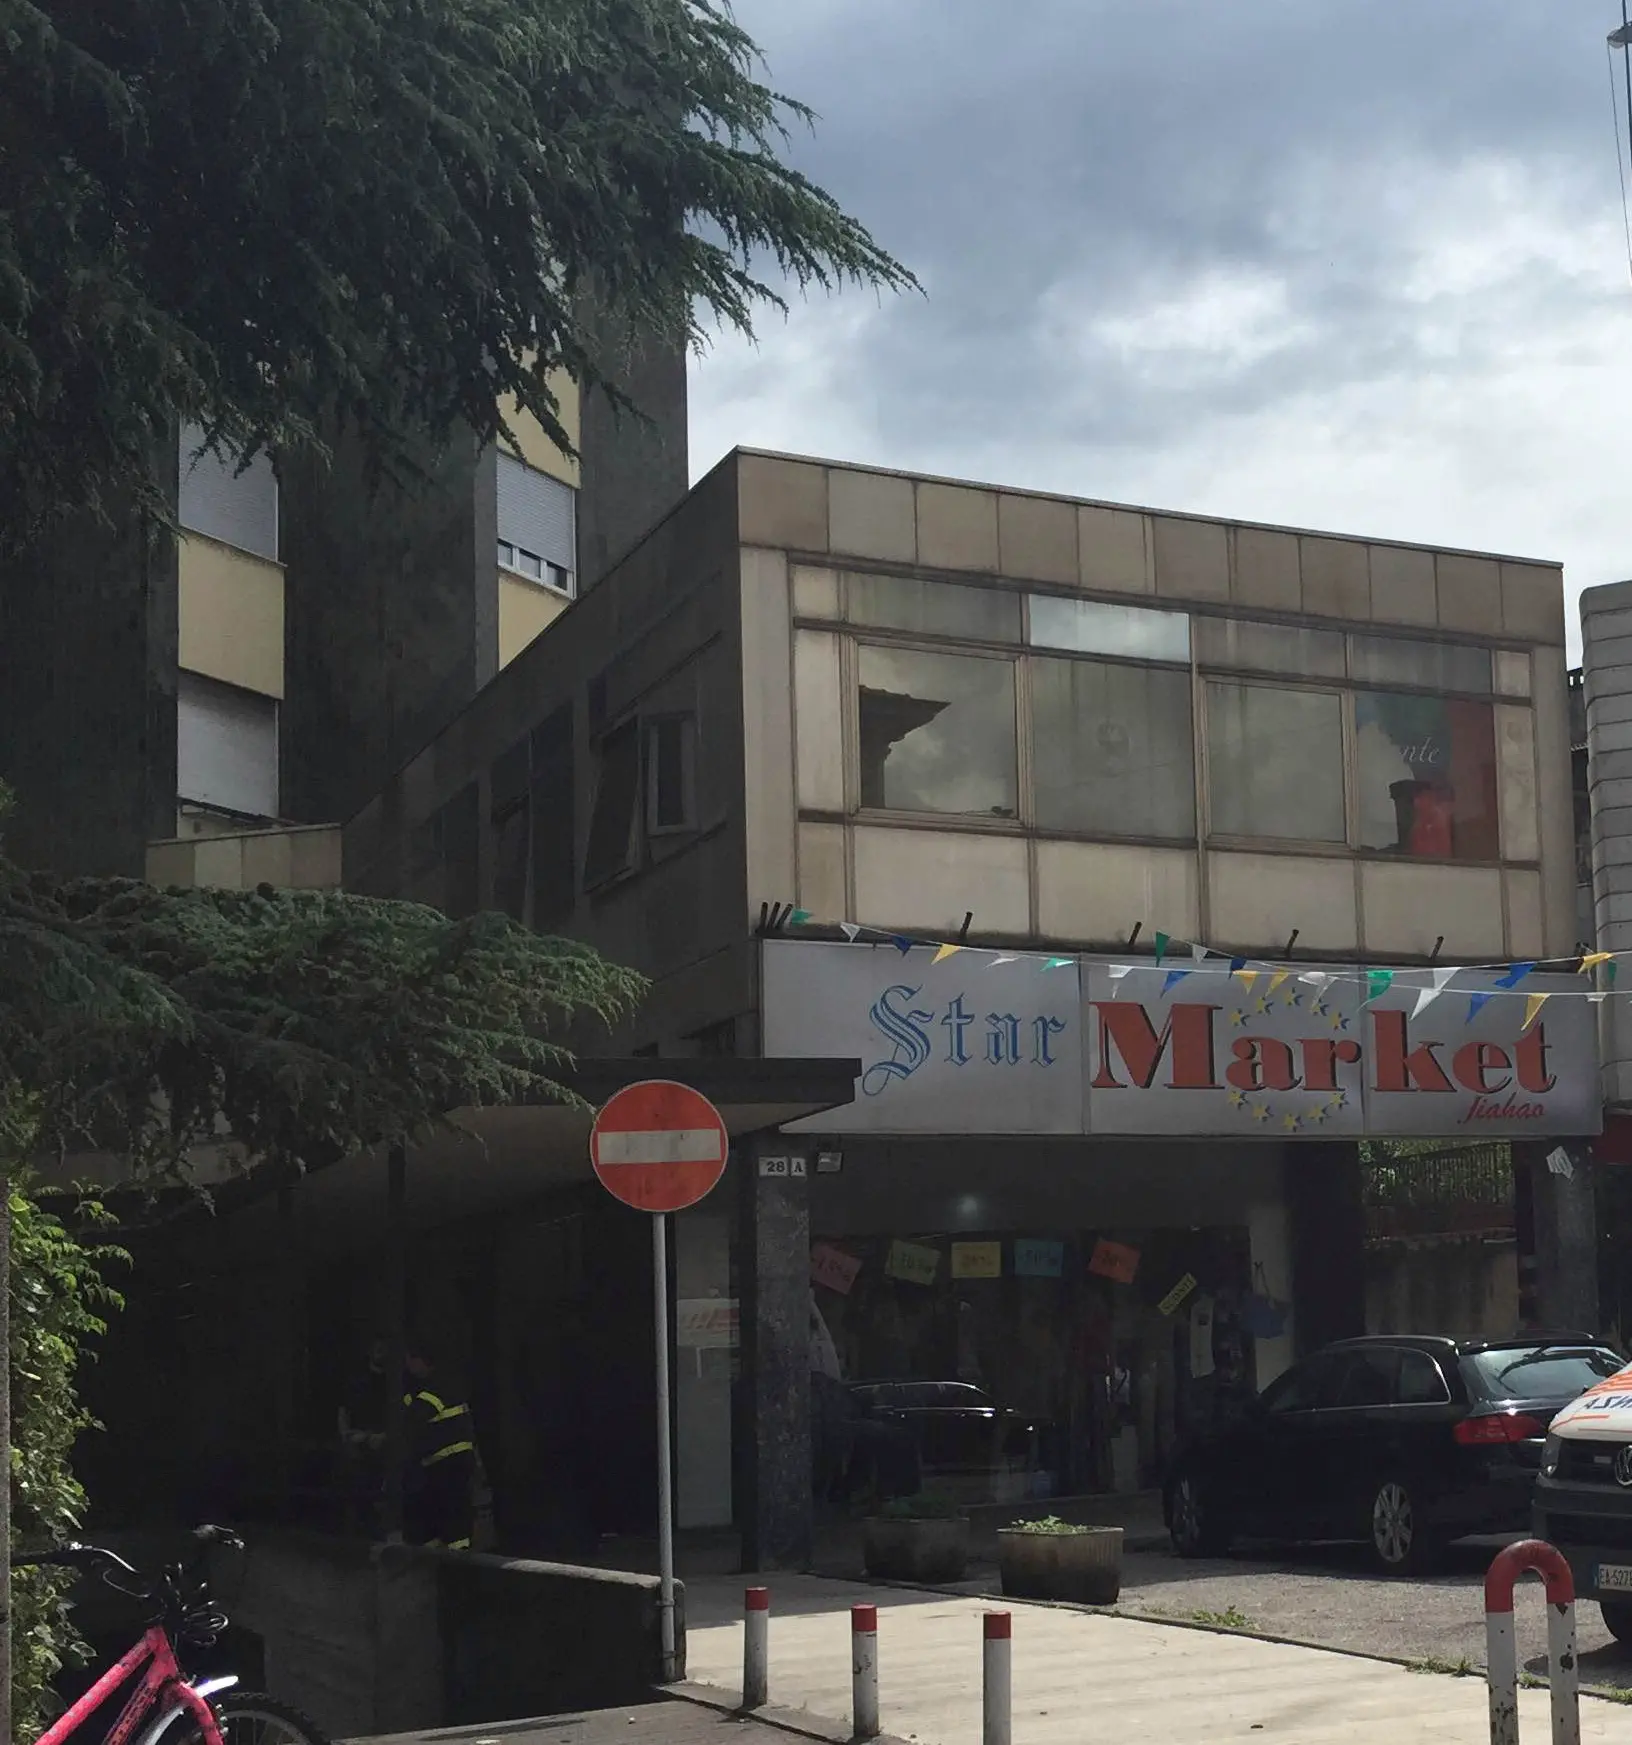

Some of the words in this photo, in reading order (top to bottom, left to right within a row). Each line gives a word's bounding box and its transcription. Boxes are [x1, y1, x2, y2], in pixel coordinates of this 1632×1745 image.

[862, 984, 1068, 1096] Star
[1090, 1001, 1558, 1094] Market
[1457, 1093, 1546, 1124] Jiahao
